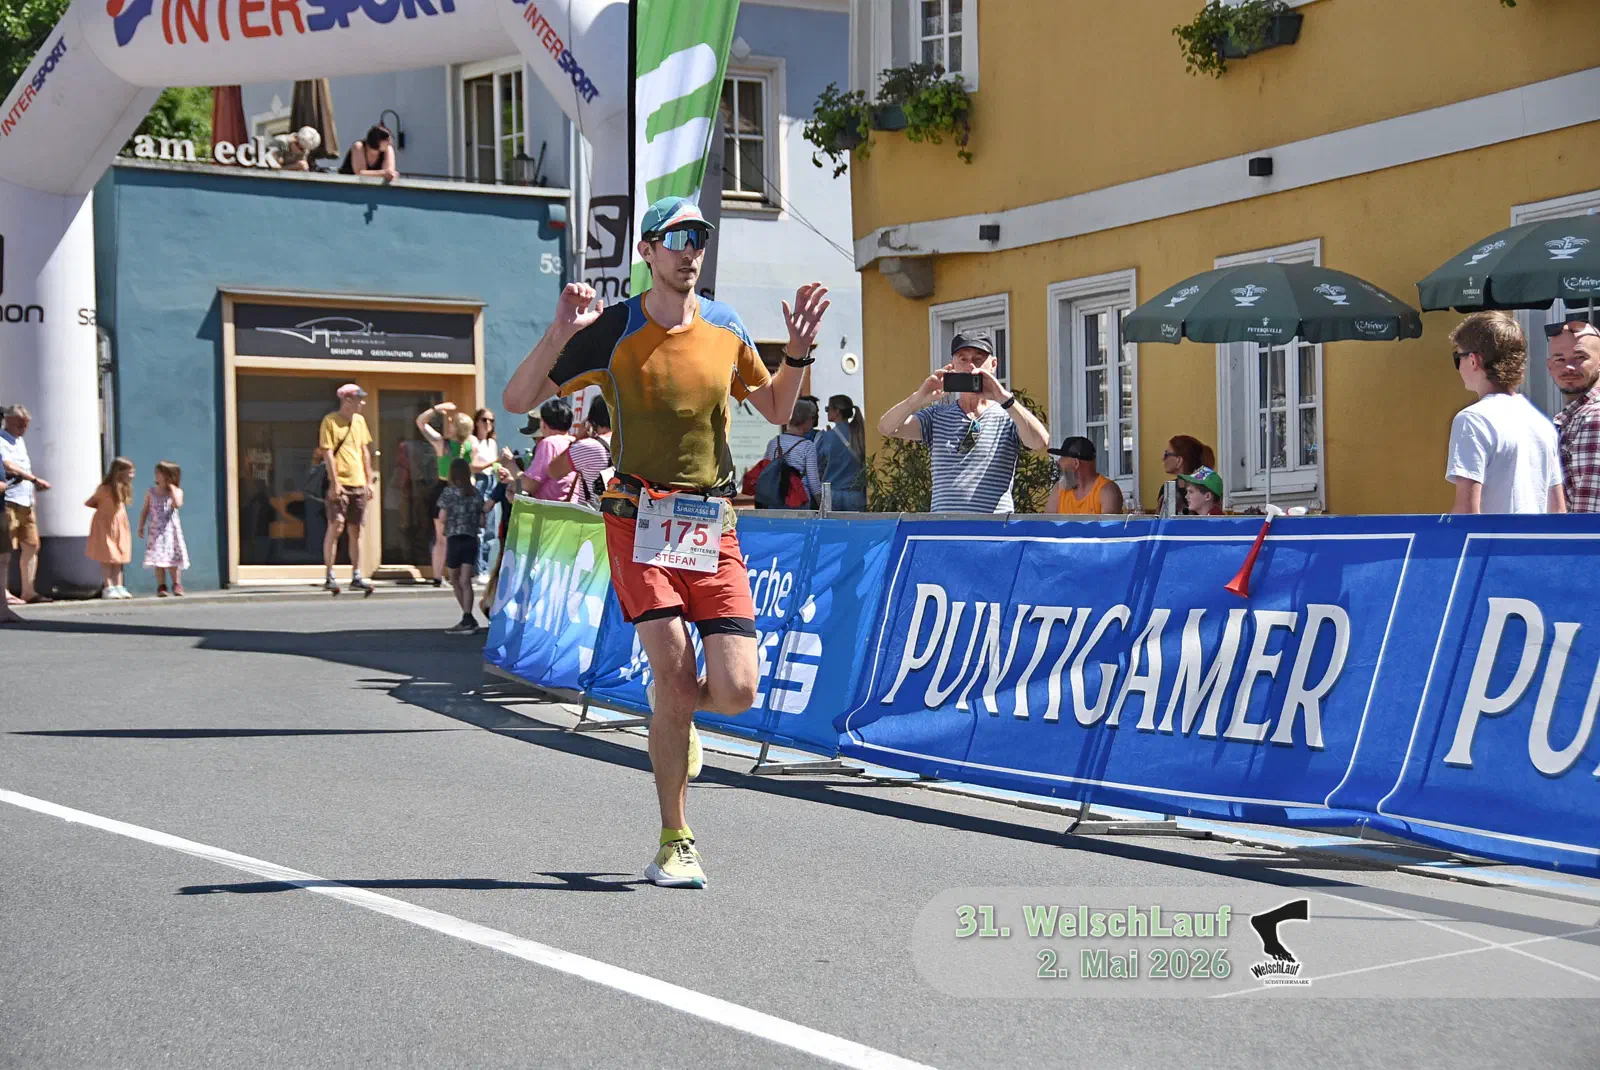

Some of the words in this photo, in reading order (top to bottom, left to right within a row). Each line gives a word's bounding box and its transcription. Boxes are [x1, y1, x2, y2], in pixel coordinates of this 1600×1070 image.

[162, 0, 457, 45] INTERS
[523, 1, 600, 104] INTERSPORT
[1, 35, 68, 137] INTERSPORT
[134, 134, 197, 162] am
[214, 135, 283, 168] eck
[676, 505, 709, 515] SPARKASSE
[661, 518, 709, 547] 175
[655, 552, 697, 567] STEFAN
[690, 546, 717, 555] REITERER
[882, 582, 1352, 750] PUNTIGAMER
